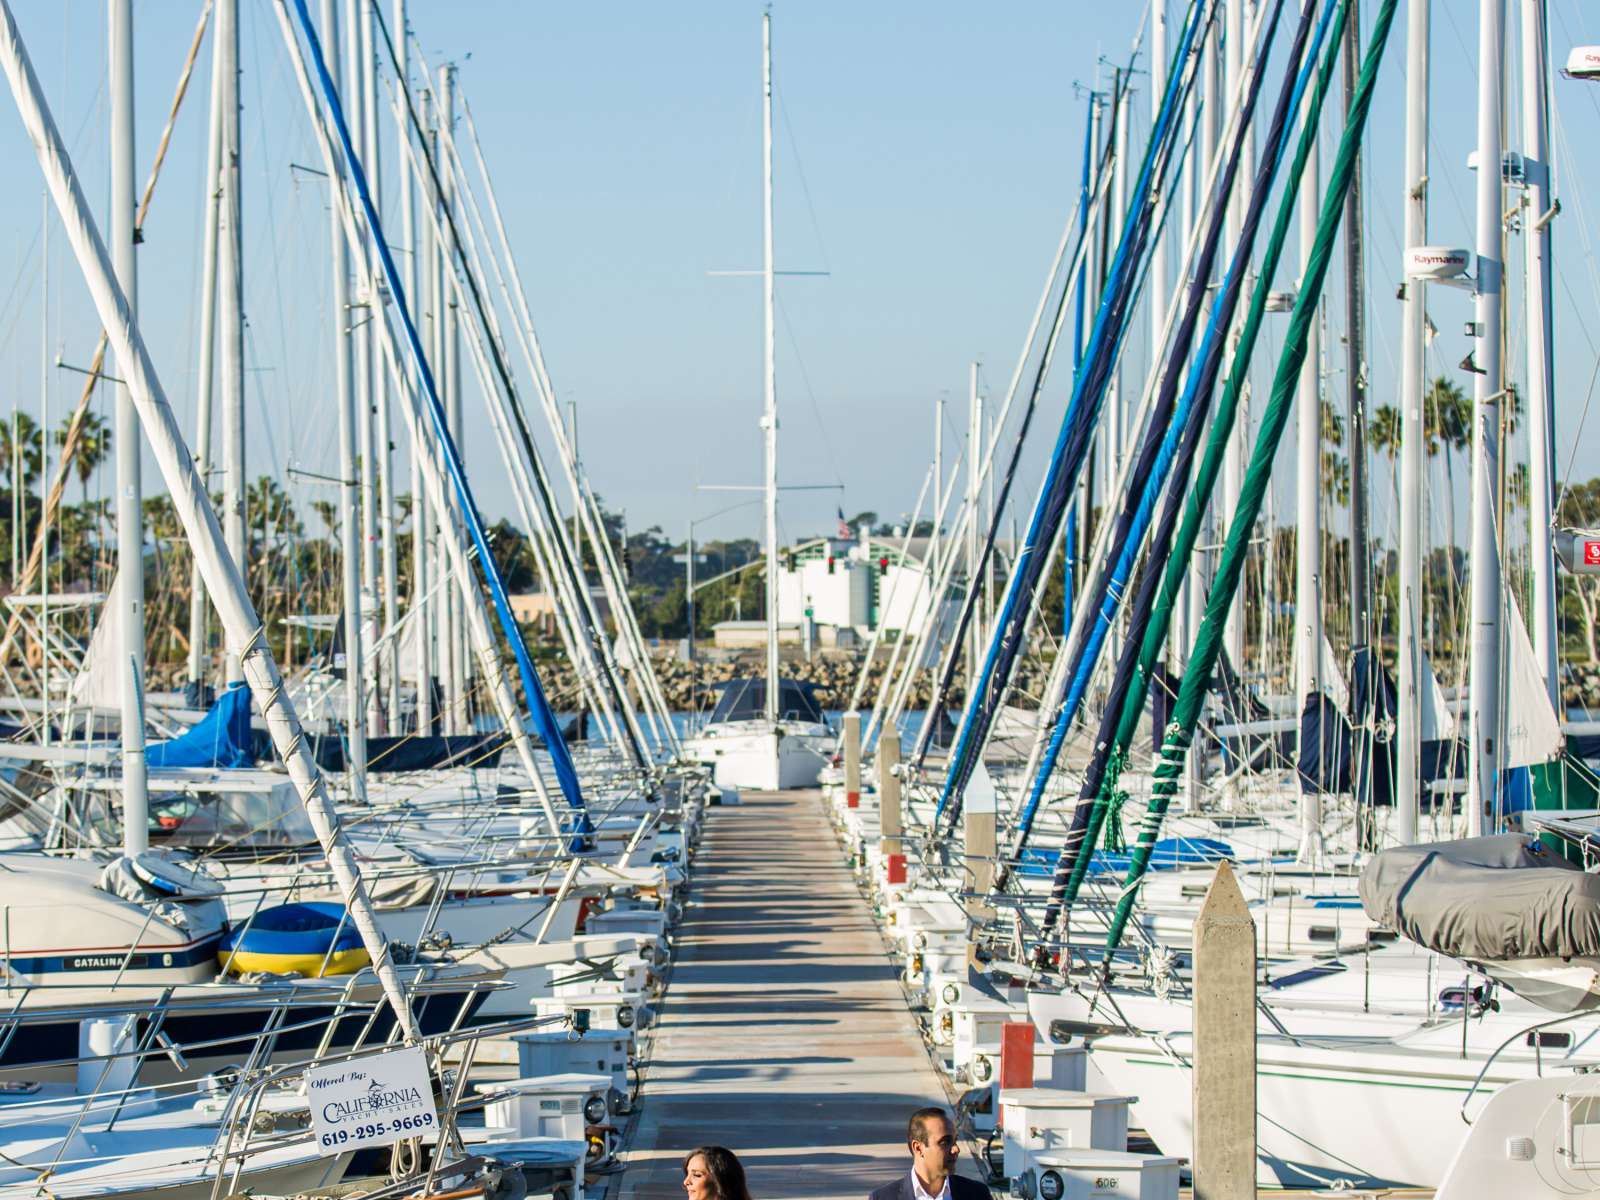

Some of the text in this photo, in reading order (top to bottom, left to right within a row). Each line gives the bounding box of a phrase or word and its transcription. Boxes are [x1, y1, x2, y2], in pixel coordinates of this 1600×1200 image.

[1414, 255, 1465, 265] Raymarine
[74, 957, 124, 968] CATALINA
[311, 1071, 367, 1089] Offered By:
[323, 1087, 421, 1124] CALIFORNIA
[343, 1102, 424, 1122] YACHT SALES
[322, 1112, 433, 1147] 619-295-9669
